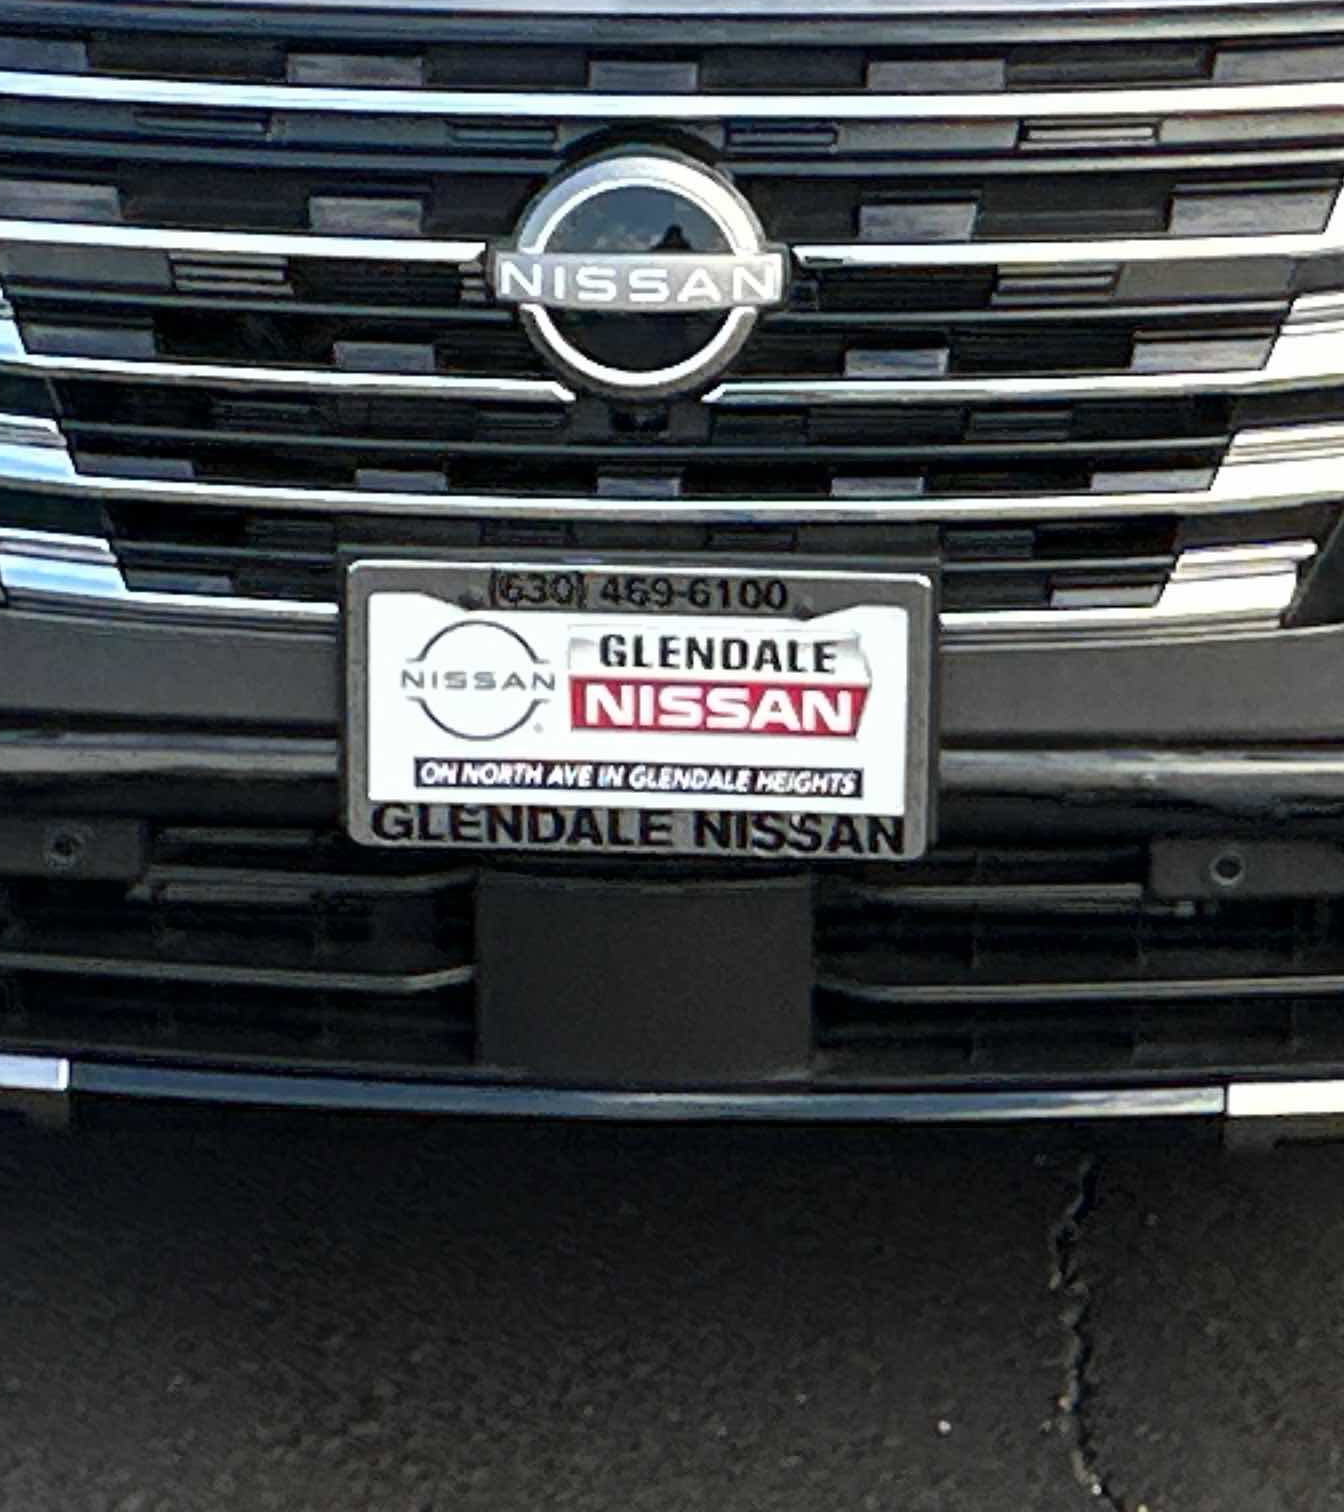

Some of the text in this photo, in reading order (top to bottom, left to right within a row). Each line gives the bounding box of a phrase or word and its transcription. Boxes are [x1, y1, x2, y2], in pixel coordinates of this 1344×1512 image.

[500, 260, 773, 303] NISSAN
[488, 568, 790, 611] (630) 469-6100
[599, 633, 837, 674] GLENDALE
[401, 669, 556, 691] NISSAN
[585, 683, 853, 732] NISSAN
[420, 762, 856, 794] ON NORTH AVE IN GLENDALE HEIGHTS
[371, 802, 905, 855] GLENDALE NISSAN
